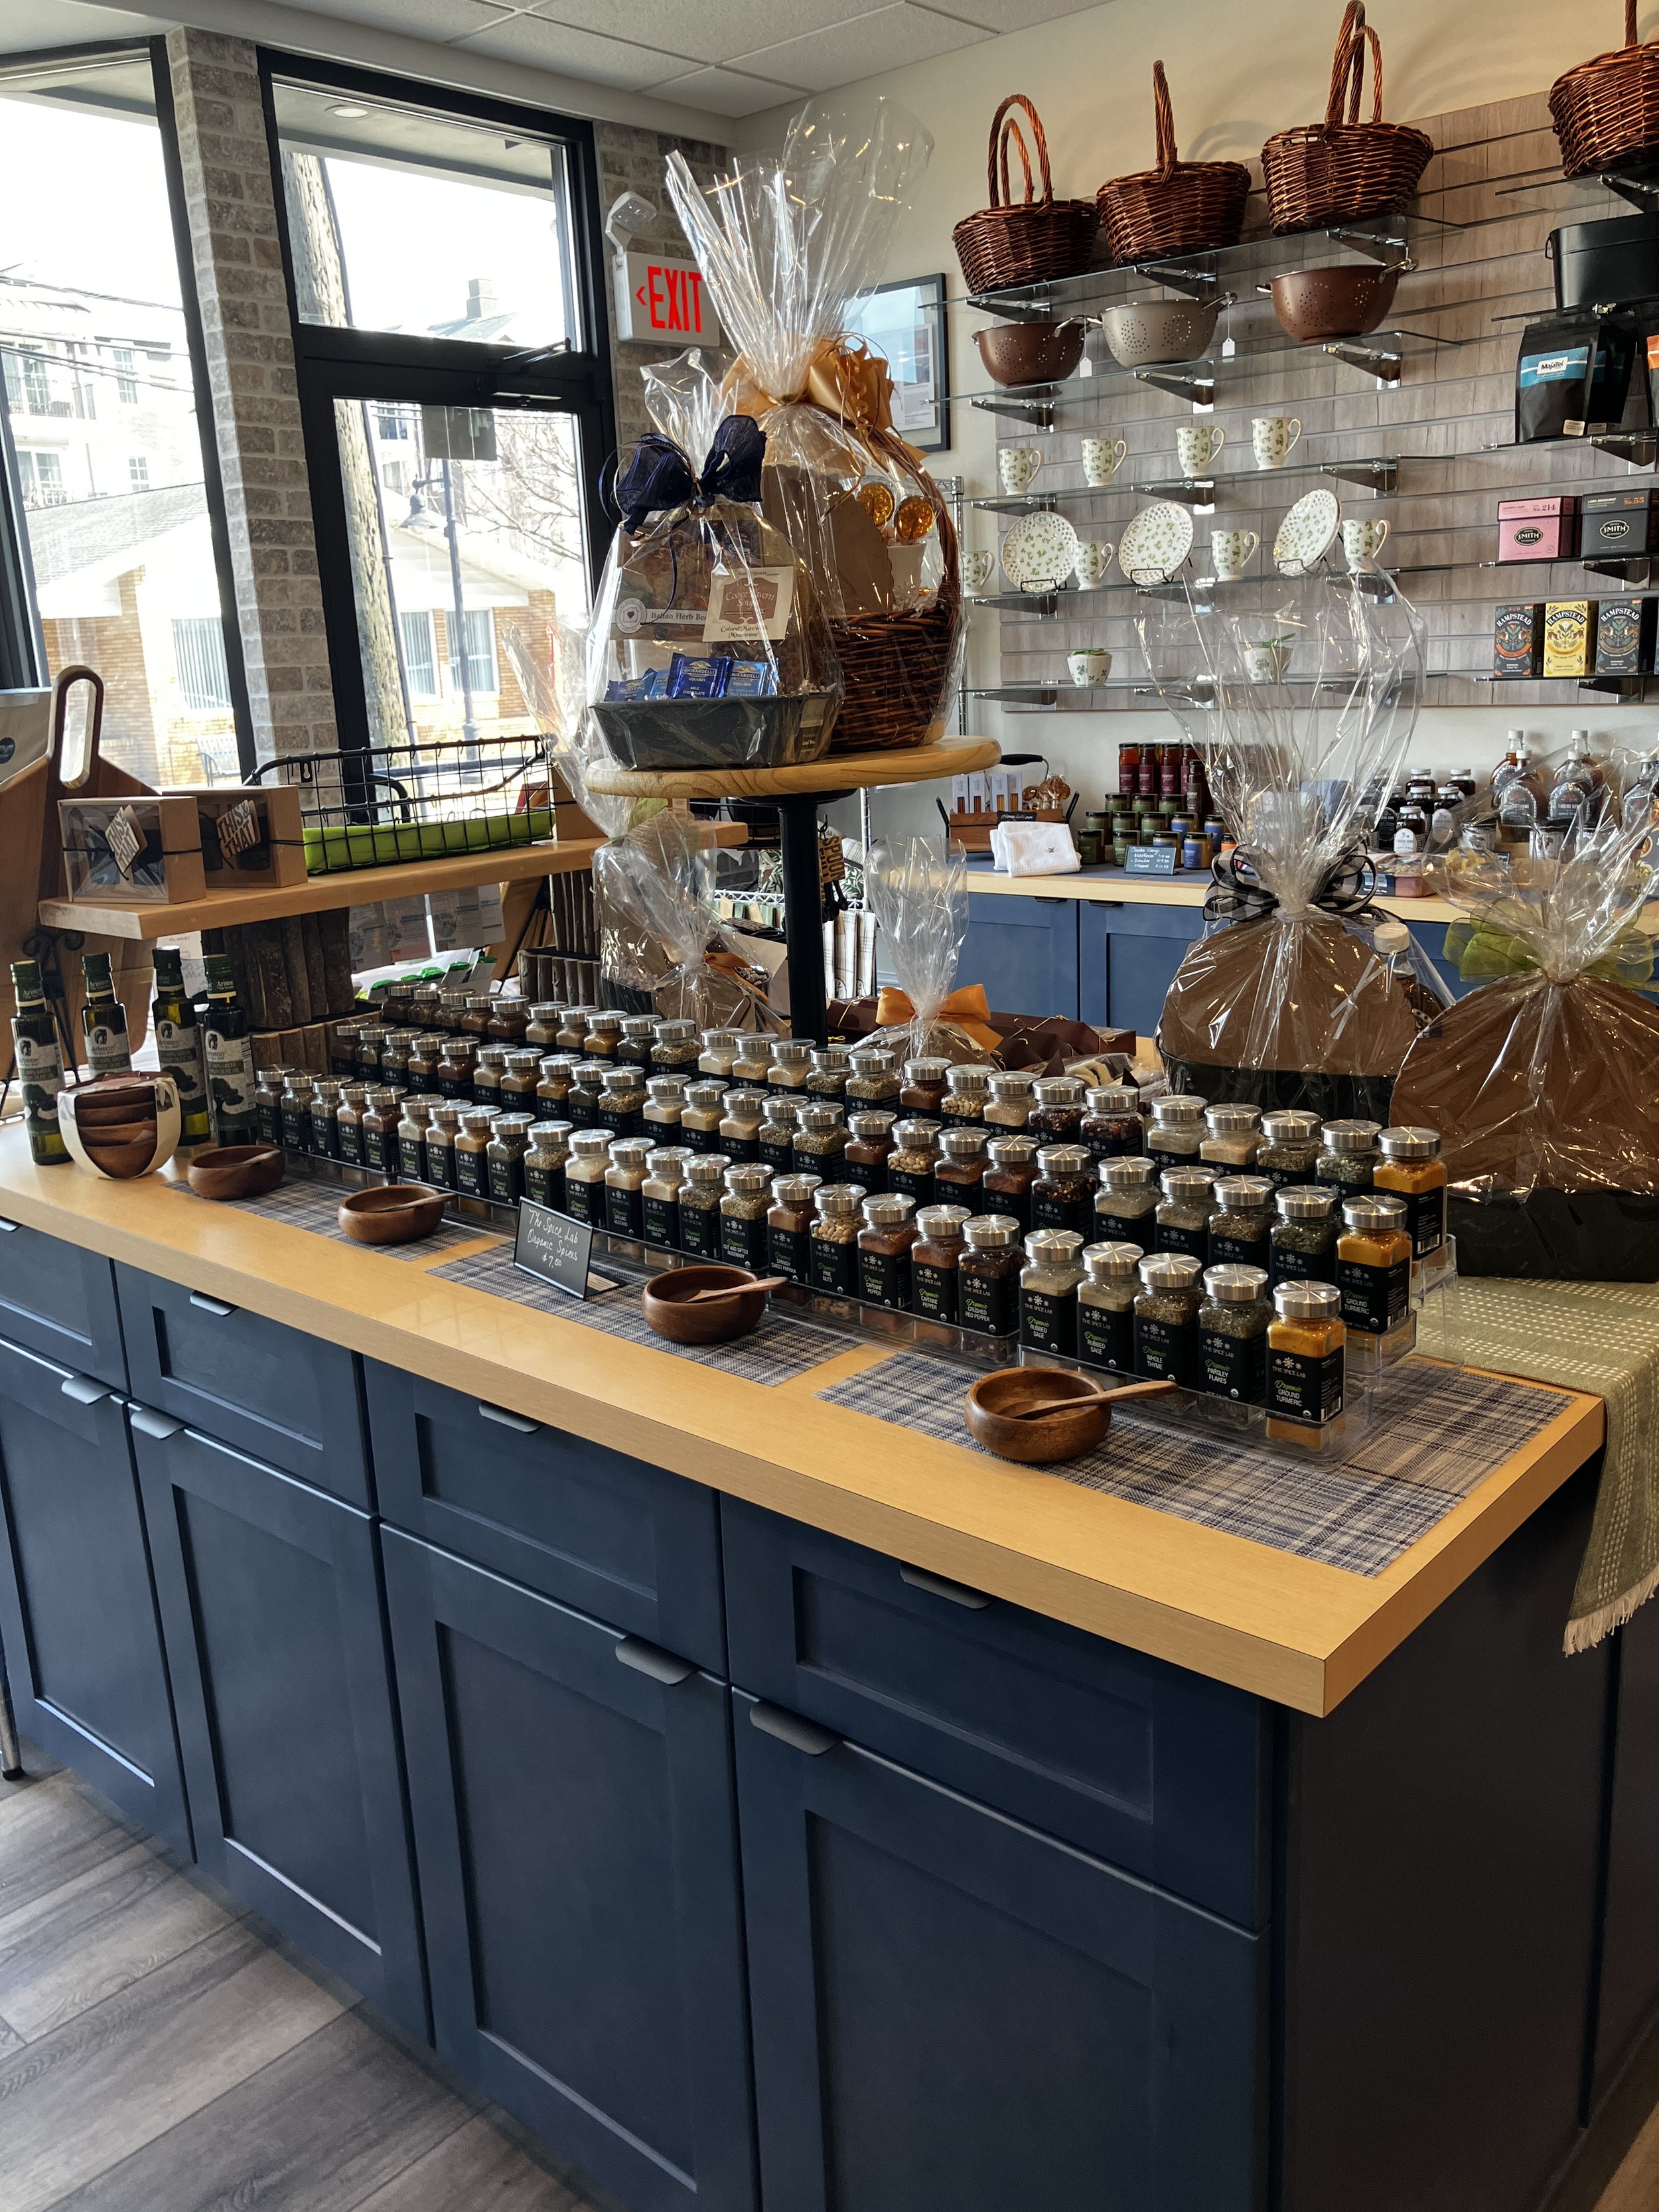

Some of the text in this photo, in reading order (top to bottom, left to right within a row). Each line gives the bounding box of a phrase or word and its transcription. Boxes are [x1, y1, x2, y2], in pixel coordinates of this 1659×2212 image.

[648, 266, 703, 332] EXIT
[1496, 613, 1532, 627] HAMPSTEAD
[1548, 611, 1585, 625] HAMPSTEAD
[1601, 607, 1640, 622] HAMPSTEAD
[218, 806, 245, 843] THIS
[107, 814, 125, 855] THIS
[224, 820, 255, 857] THAT
[118, 826, 137, 867] THAT
[823, 836, 845, 879] SPOON
[528, 1208, 578, 1244] The Spice Lab
[527, 1228, 578, 1261] Organic Spices
[542, 1252, 562, 1268] $7.50
[866, 1282, 883, 1291] CAYENNE
[919, 1288, 939, 1299] Organic
[1343, 1290, 1369, 1300] Organic
[922, 1301, 937, 1310] PEPPER
[966, 1298, 988, 1309] Organic
[1346, 1298, 1367, 1307] GROUND
[968, 1306, 987, 1315] CRUSHED
[1344, 1304, 1370, 1314] TURMERIC
[974, 1313, 990, 1322] PEPPER
[1027, 1316, 1050, 1327] Organic
[1030, 1324, 1047, 1333] RUBBED
[1084, 1331, 1108, 1343] Organic
[1087, 1339, 1106, 1349] RUBBED
[1142, 1346, 1167, 1358] Organic
[1146, 1354, 1163, 1363] WHOLE
[1147, 1361, 1163, 1370] THYME
[1204, 1359, 1230, 1371] Organic
[1207, 1367, 1228, 1378] PARSLEY
[1271, 1365, 1282, 1374] THE
[1296, 1370, 1306, 1378] LAB
[1208, 1374, 1227, 1384] FLAKES
[1274, 1380, 1303, 1392] Organic
[1278, 1389, 1300, 1398] GROUND
[1275, 1394, 1302, 1406] TURMERIC
